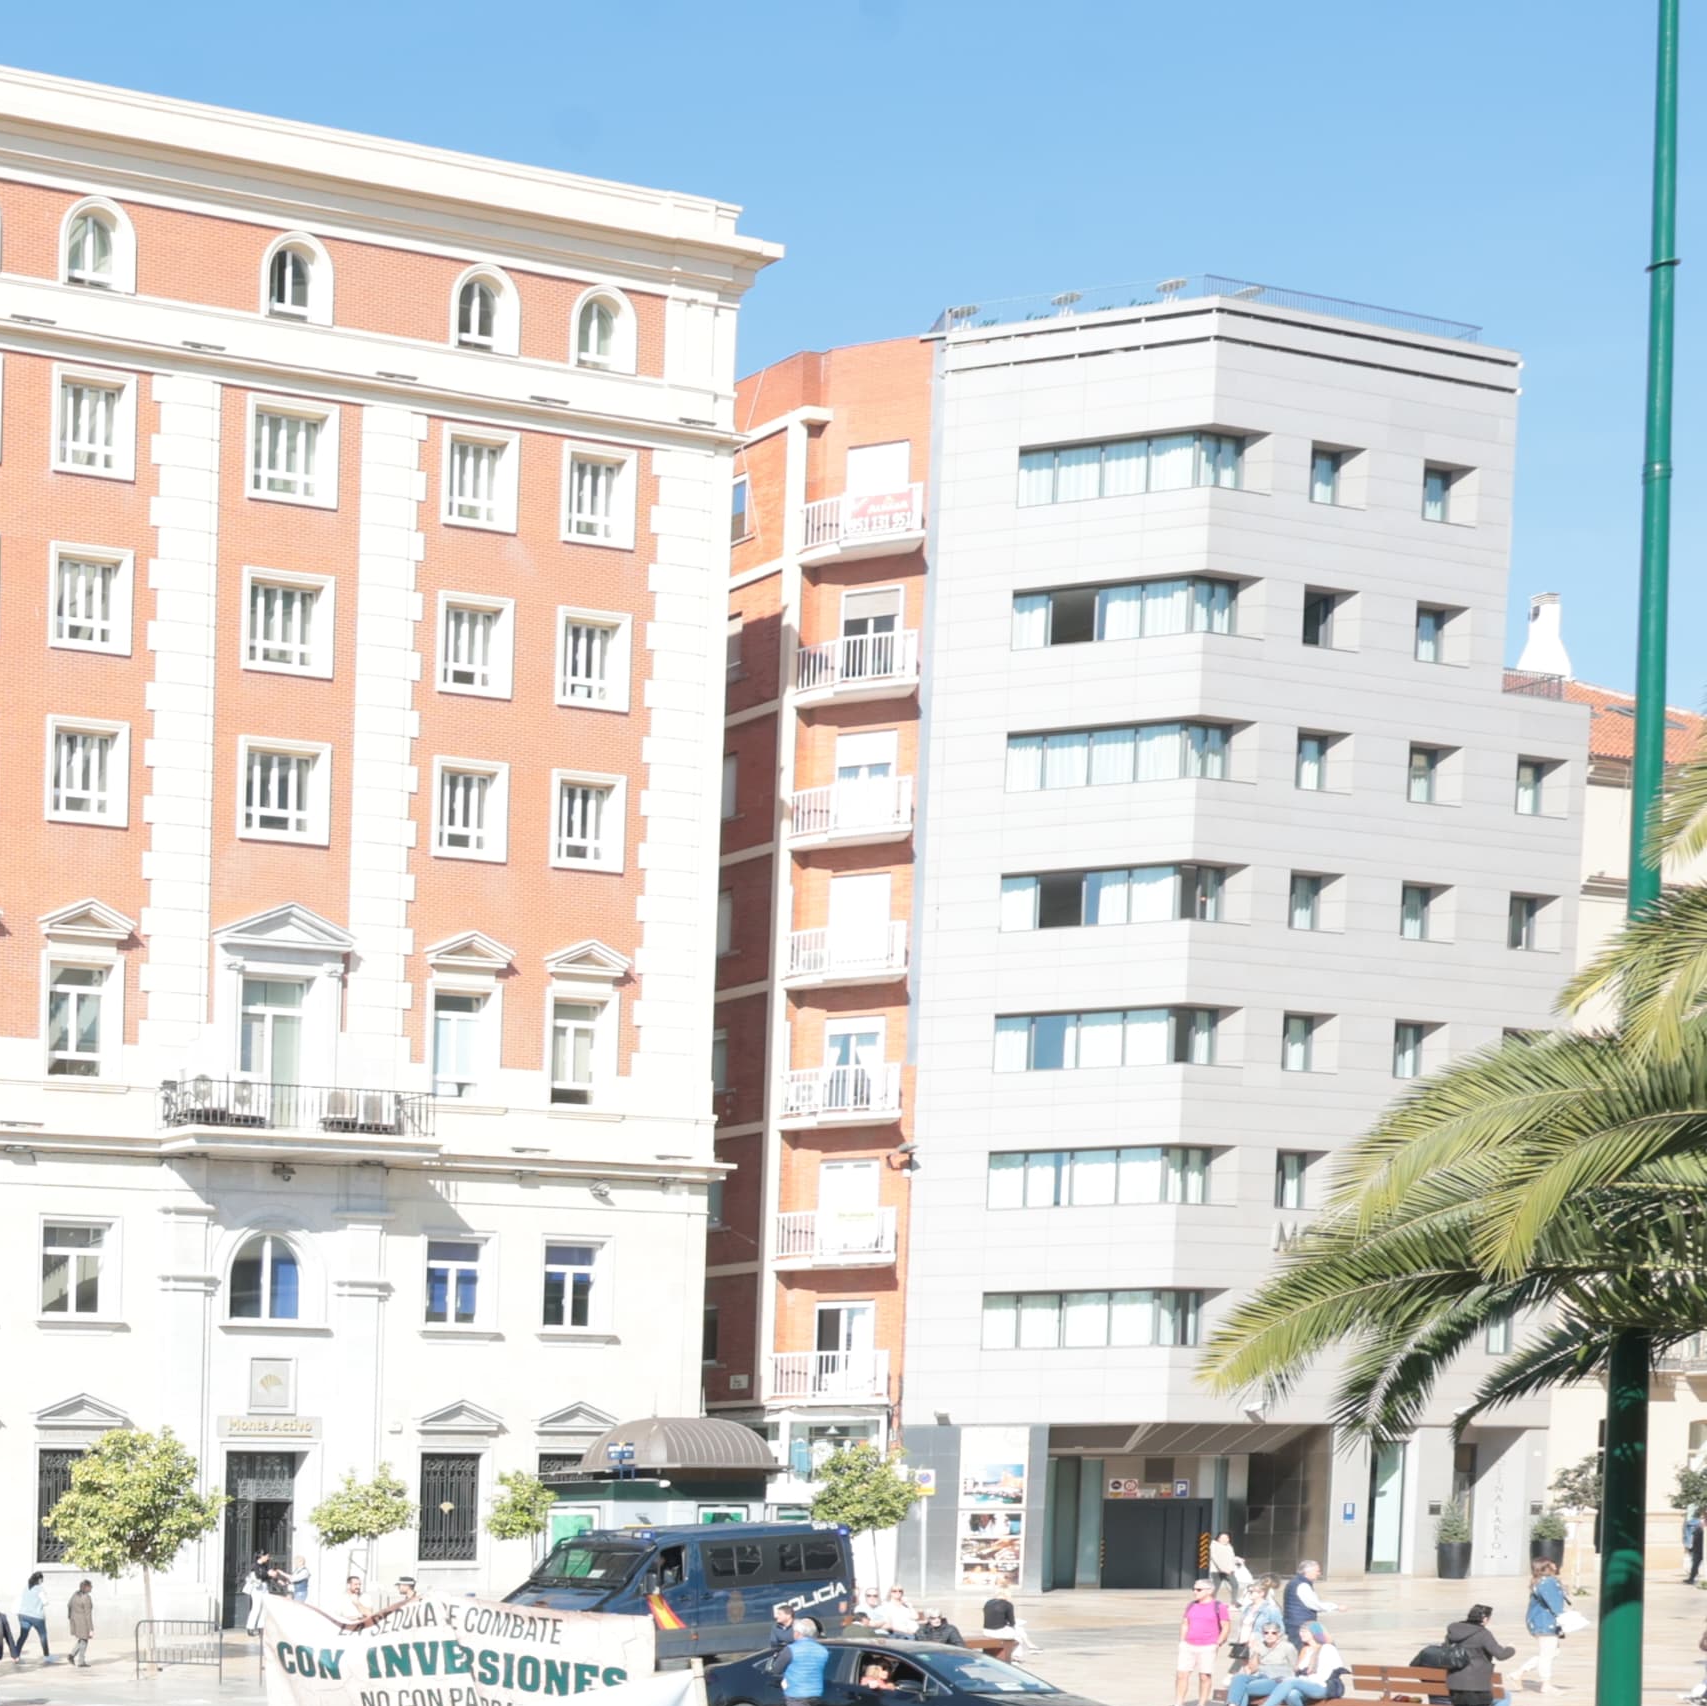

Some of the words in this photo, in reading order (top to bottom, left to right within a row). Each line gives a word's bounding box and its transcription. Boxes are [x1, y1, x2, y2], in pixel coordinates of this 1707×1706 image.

[463, 1606, 564, 1646] COMBATE
[276, 1640, 345, 1681] CON
[366, 1639, 628, 1697] INVERSIONES
